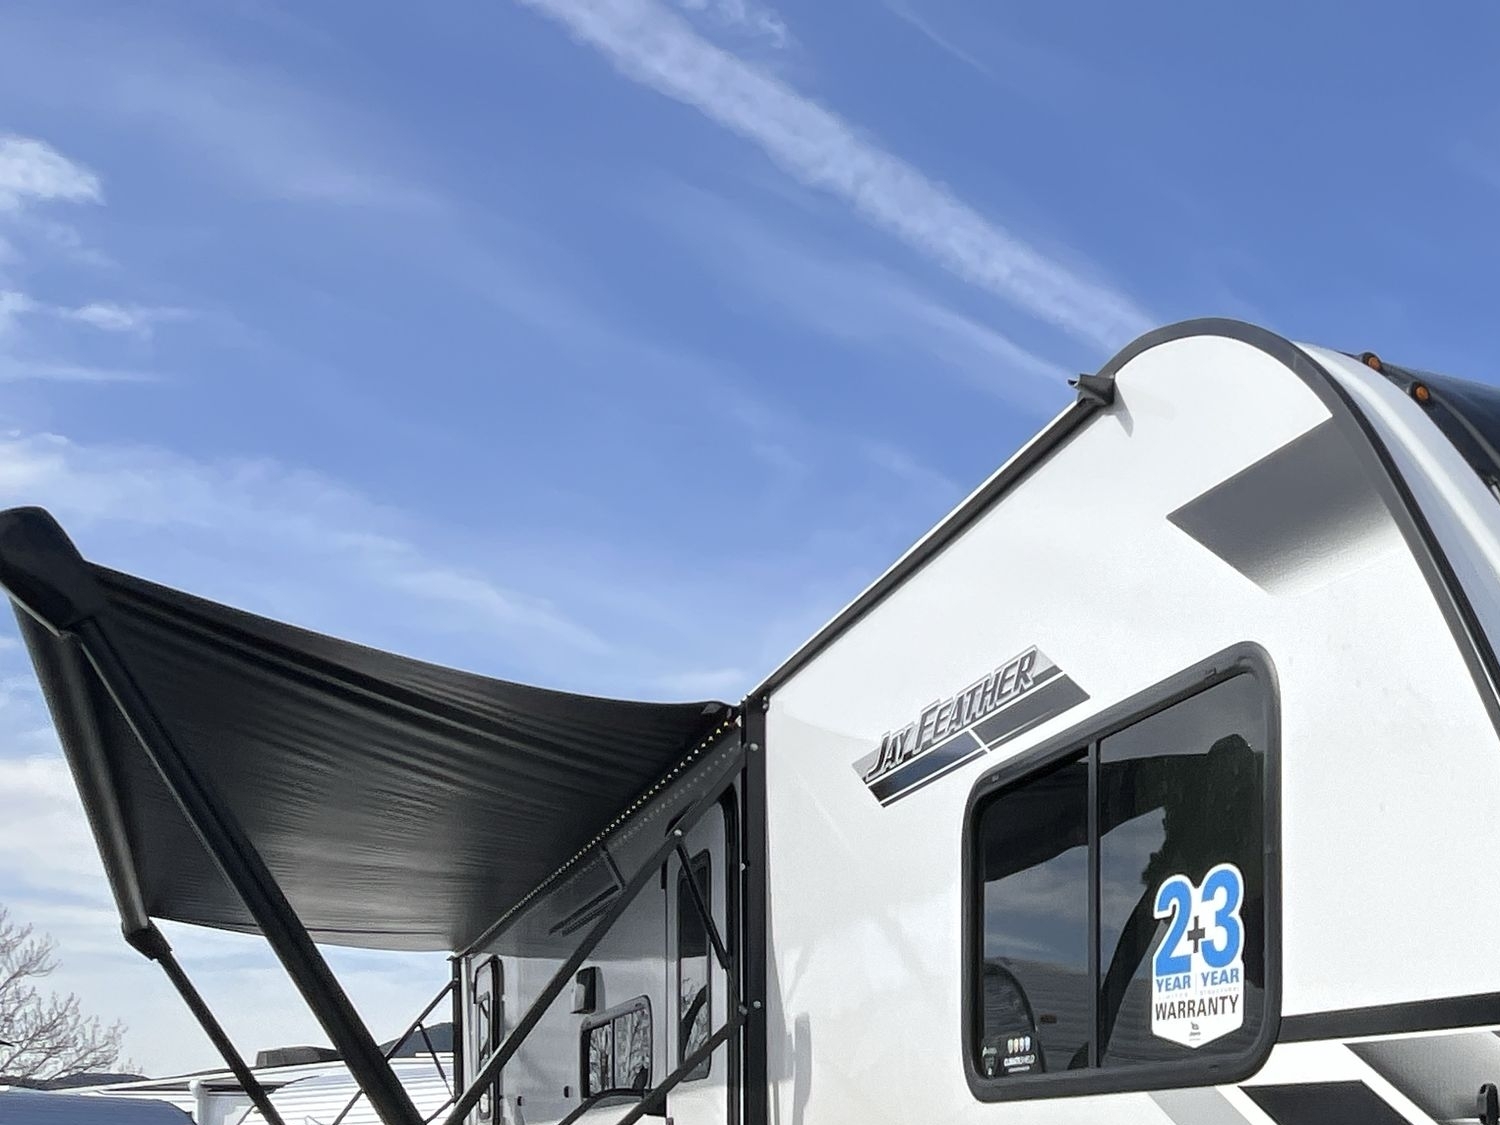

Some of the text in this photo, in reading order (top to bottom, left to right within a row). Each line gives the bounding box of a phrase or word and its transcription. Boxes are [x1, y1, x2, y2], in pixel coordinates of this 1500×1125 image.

[912, 647, 1037, 754] FEATHER
[1156, 967, 1240, 993] YEAR YEAR
[1155, 994, 1239, 1021] WARRANTY
